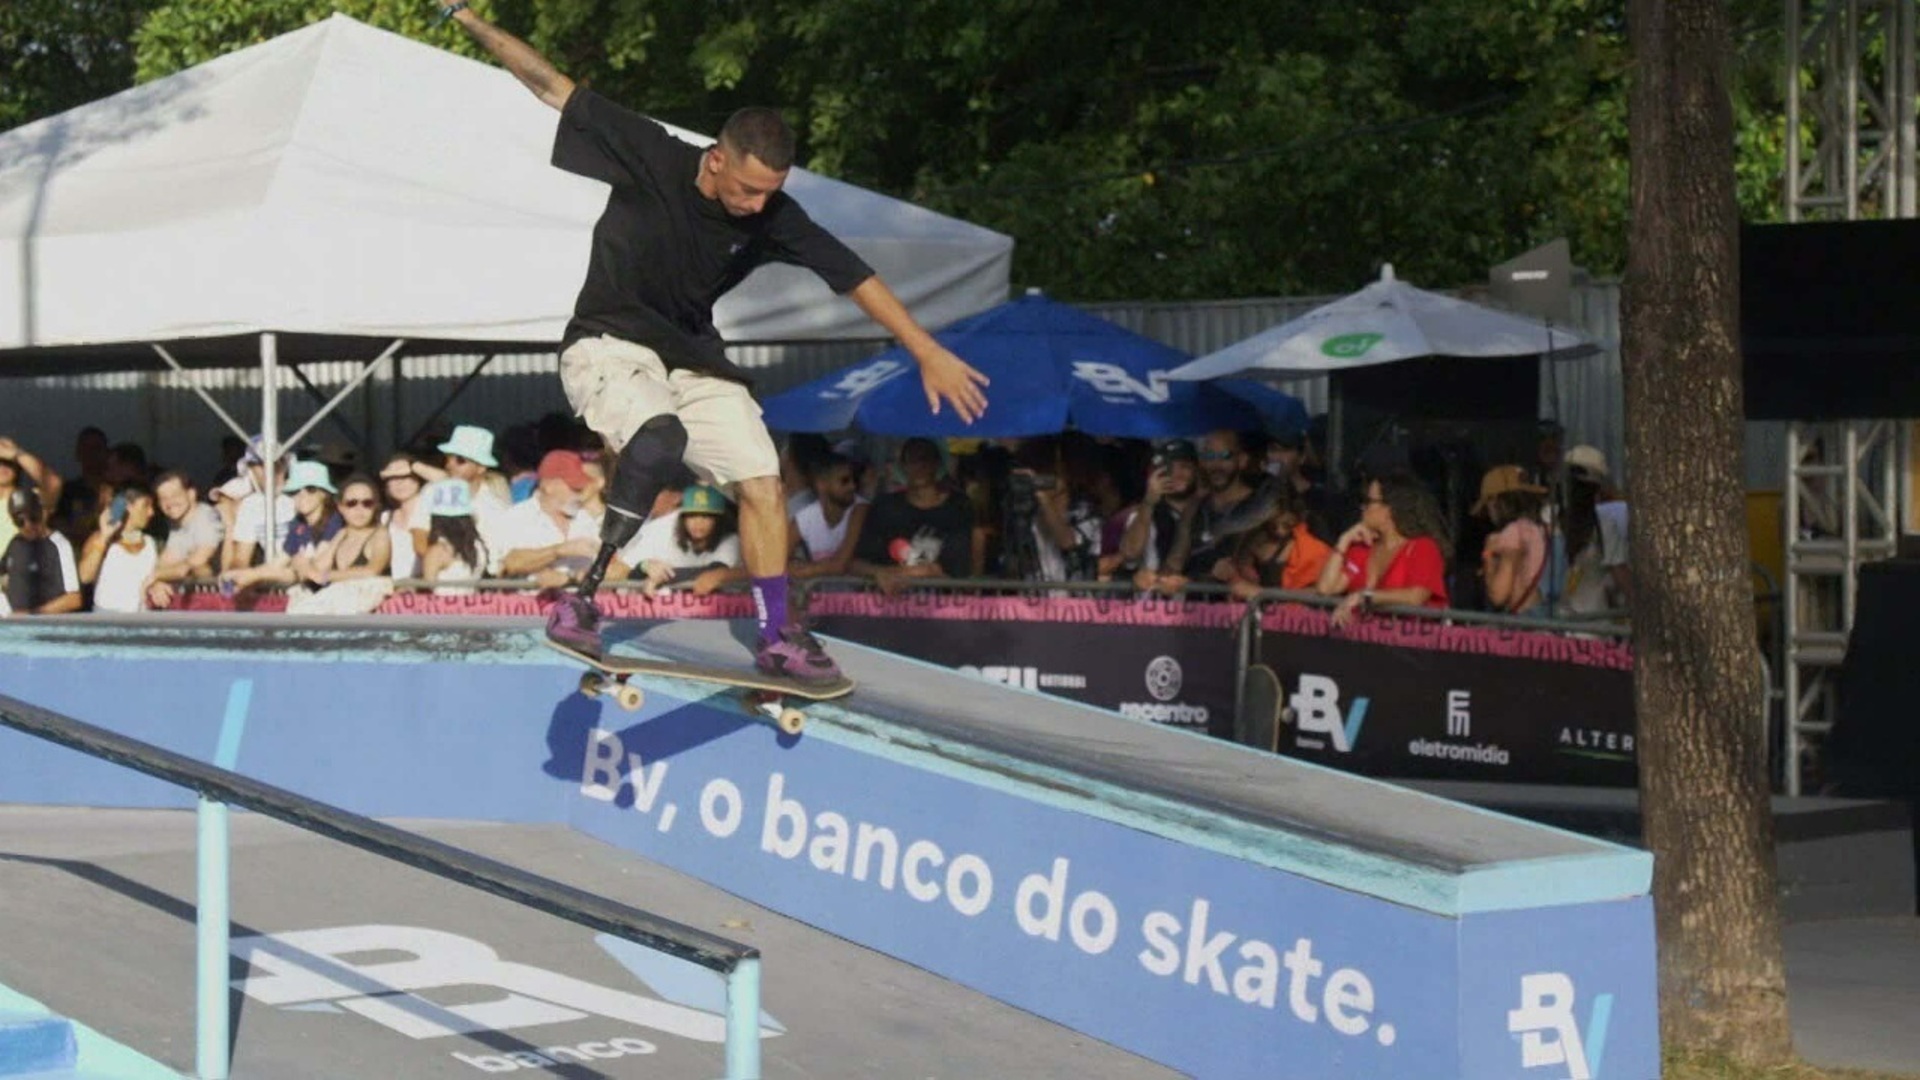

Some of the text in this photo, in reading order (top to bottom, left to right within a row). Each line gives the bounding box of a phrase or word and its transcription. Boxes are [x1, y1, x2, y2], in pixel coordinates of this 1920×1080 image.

[699, 777, 742, 838] o
[761, 772, 993, 917] banco
[1014, 857, 1117, 955] do
[1137, 898, 1397, 1047] skate.
[451, 1037, 657, 1072] banco
